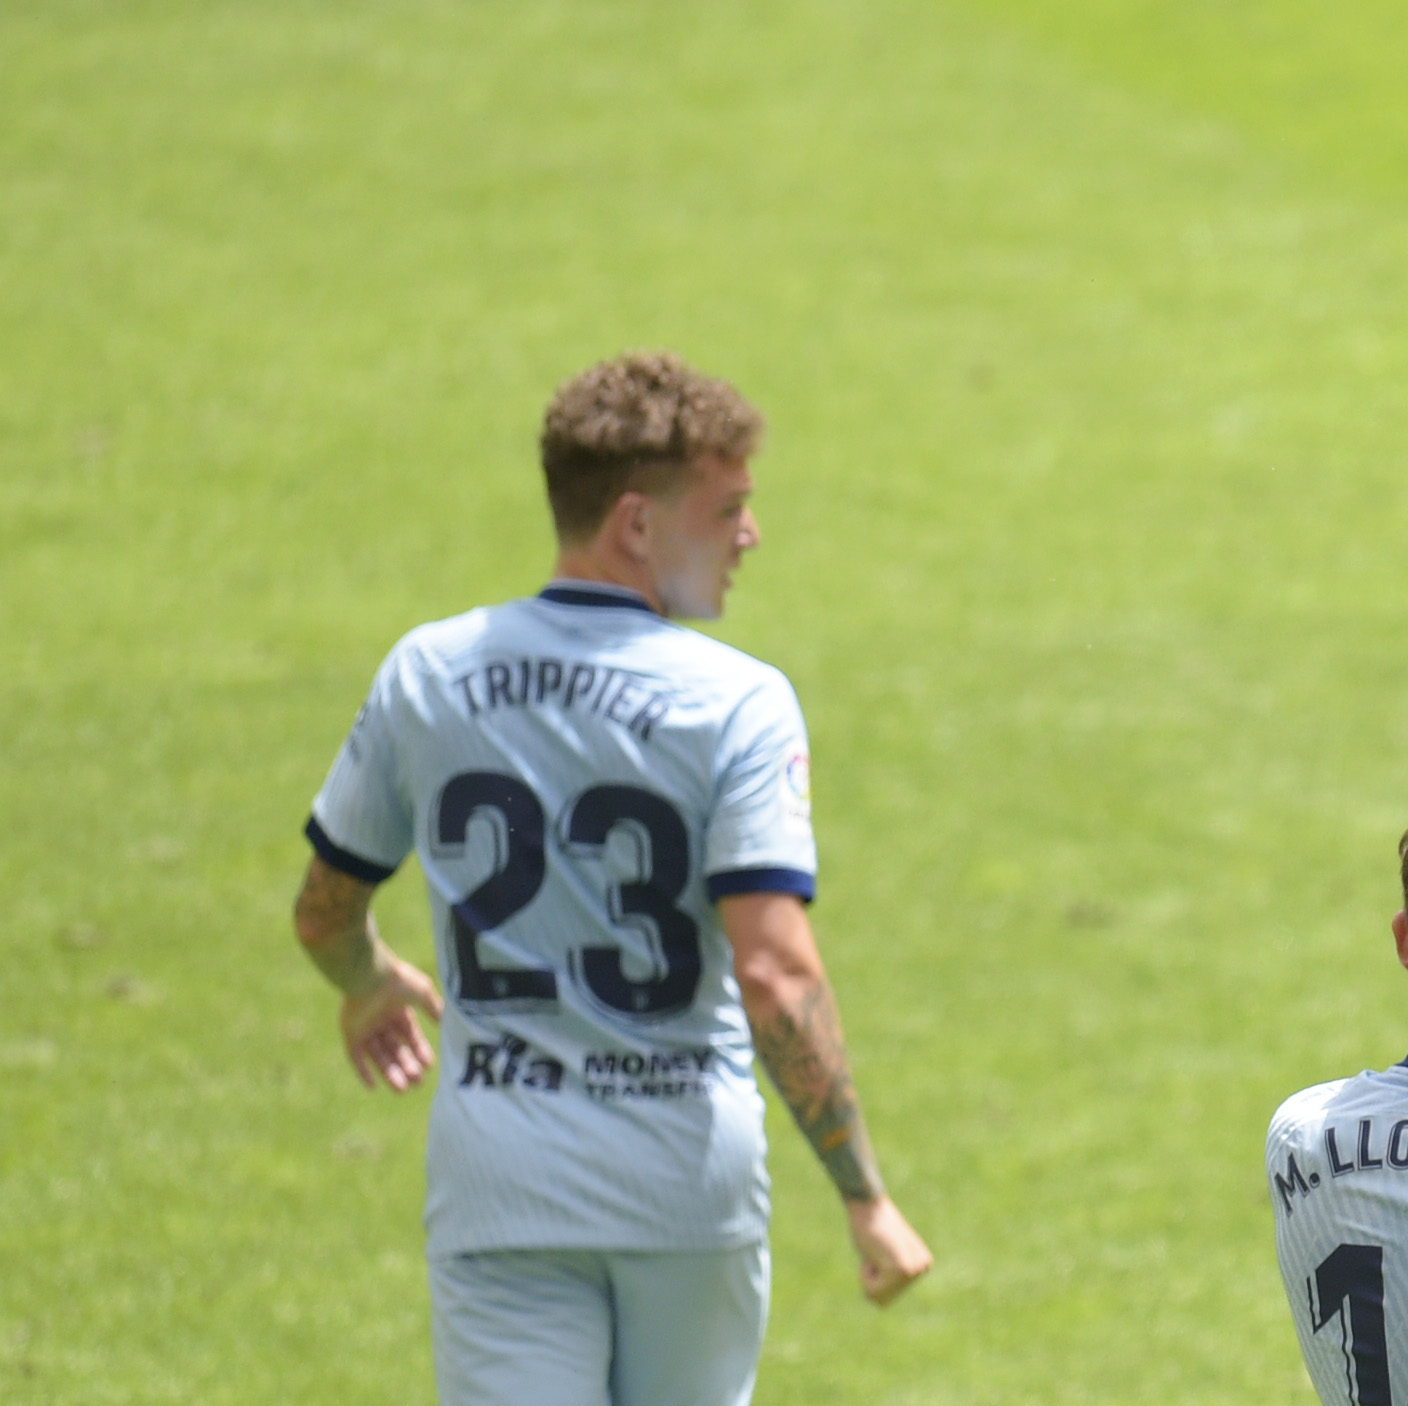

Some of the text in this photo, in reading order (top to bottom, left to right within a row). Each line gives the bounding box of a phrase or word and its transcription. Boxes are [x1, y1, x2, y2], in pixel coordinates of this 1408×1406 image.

[453, 656, 670, 742] TRIPPIER
[427, 770, 704, 1022] 23
[458, 1033, 564, 1092] Ria
[585, 1050, 717, 1074] MONEY
[1274, 1152, 1321, 1218] M.
